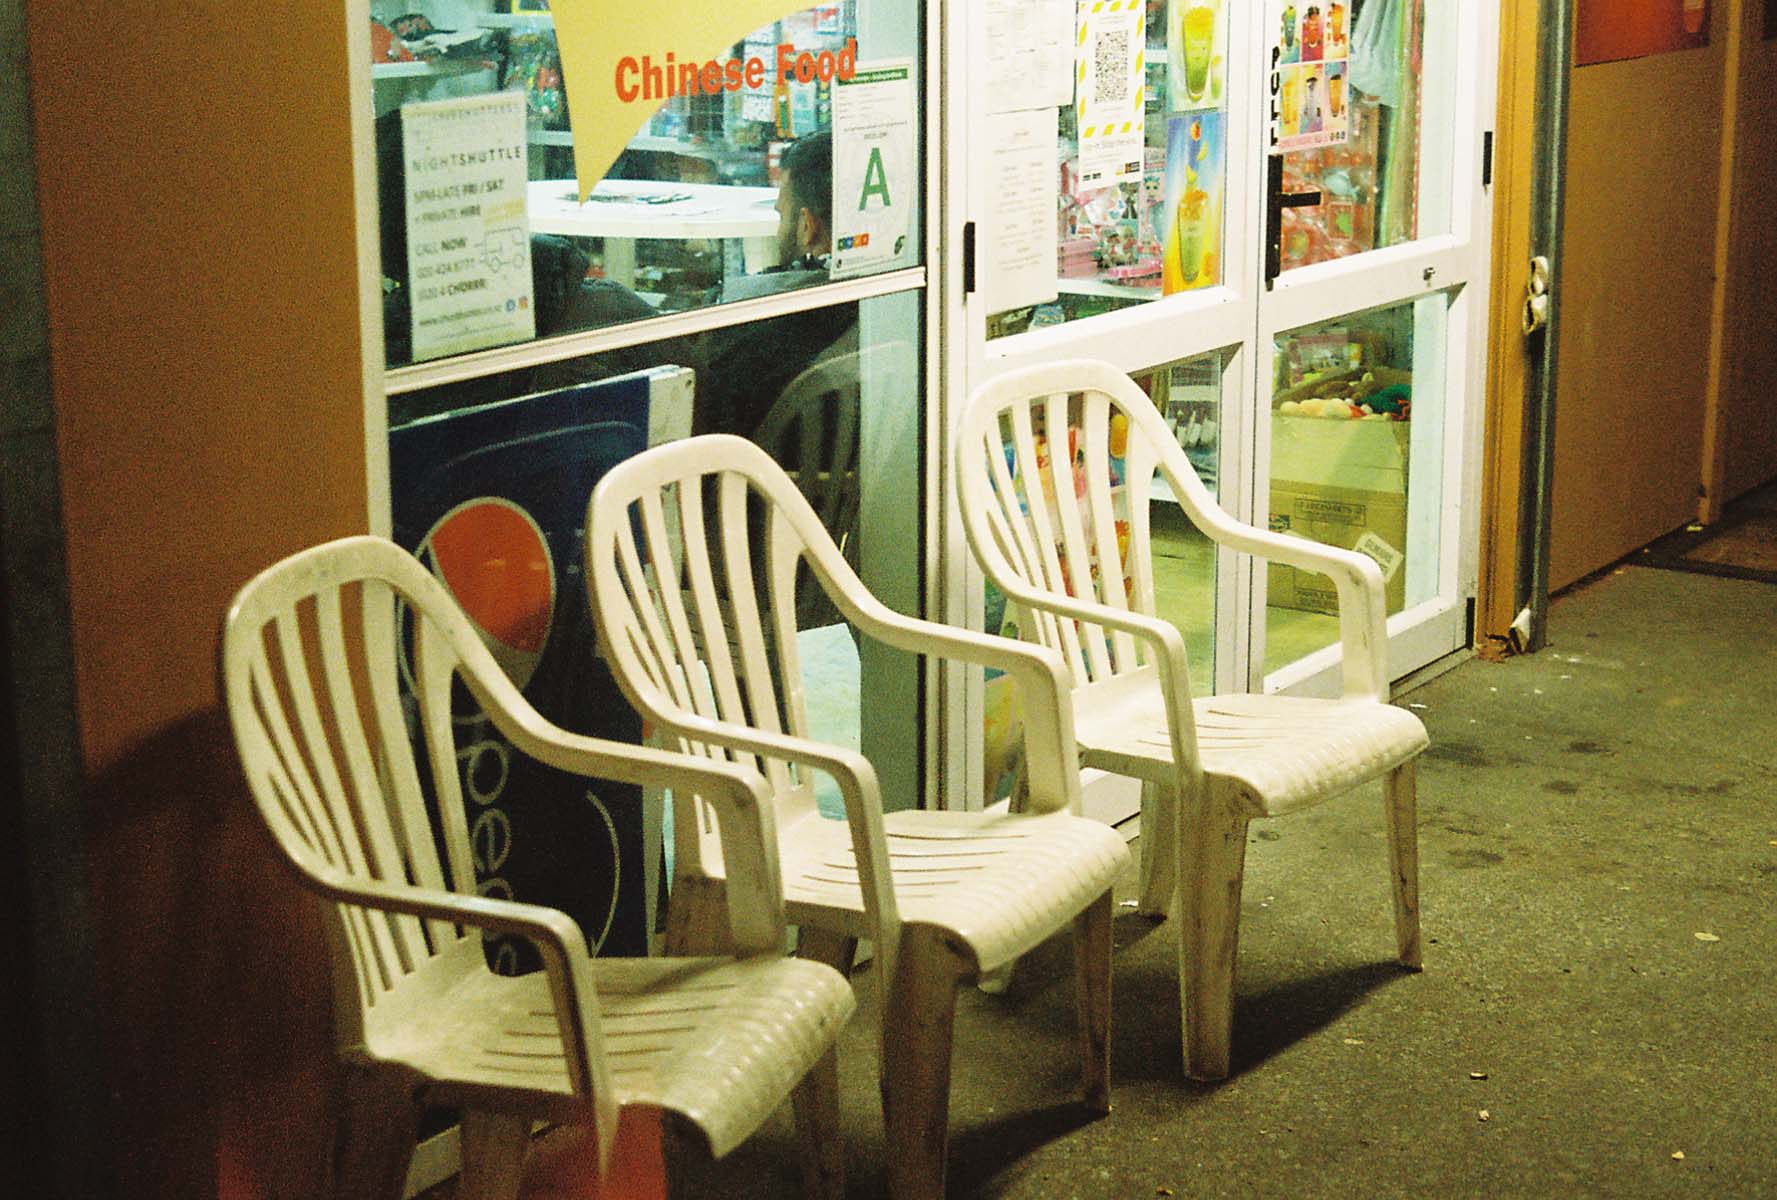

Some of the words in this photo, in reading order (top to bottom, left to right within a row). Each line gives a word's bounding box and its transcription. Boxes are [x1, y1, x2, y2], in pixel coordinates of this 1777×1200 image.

[615, 52, 765, 103] Chinese
[776, 38, 857, 87] Food
[1270, 46, 1281, 146] PULL
[412, 145, 521, 173] NIGHTSHUTTLE
[858, 147, 891, 211] A
[441, 237, 467, 251] NOW
